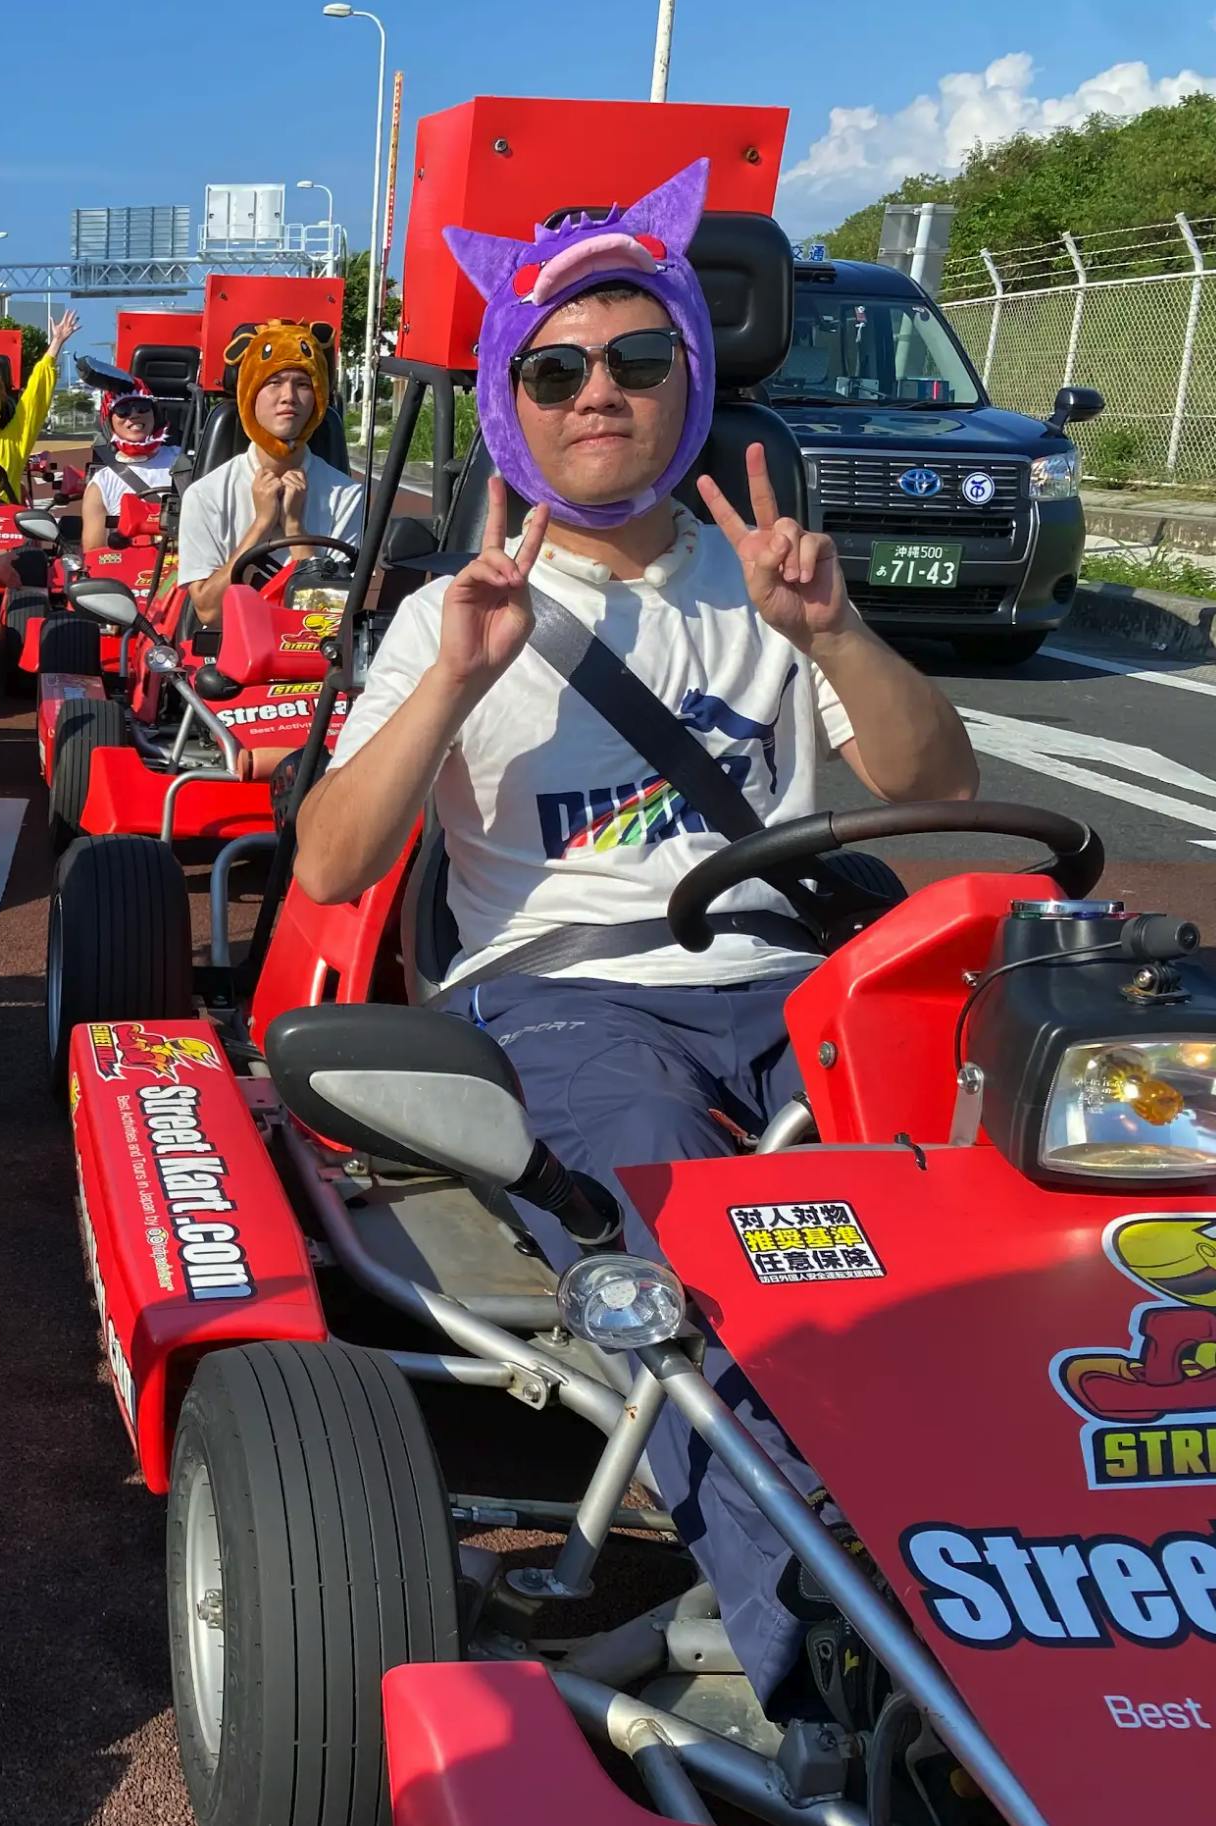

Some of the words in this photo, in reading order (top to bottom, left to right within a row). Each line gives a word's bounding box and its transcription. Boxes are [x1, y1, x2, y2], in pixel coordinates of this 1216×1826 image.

[876, 565, 887, 577] あ
[890, 560, 955, 585] 71-43
[275, 684, 320, 694] STREE
[250, 726, 275, 735] Best
[117, 1095, 131, 1111] Best
[120, 1112, 137, 1142] Activities
[140, 1086, 211, 1154] Street
[128, 1144, 142, 1157] and
[131, 1158, 148, 1180] Tours
[139, 1190, 156, 1214] Japan
[145, 1215, 159, 1226] by
[735, 1205, 851, 1229] 対人対物
[744, 1226, 863, 1252] 推奨基準
[755, 1249, 873, 1273] 任意保険
[1103, 1695, 1212, 1729] Best
